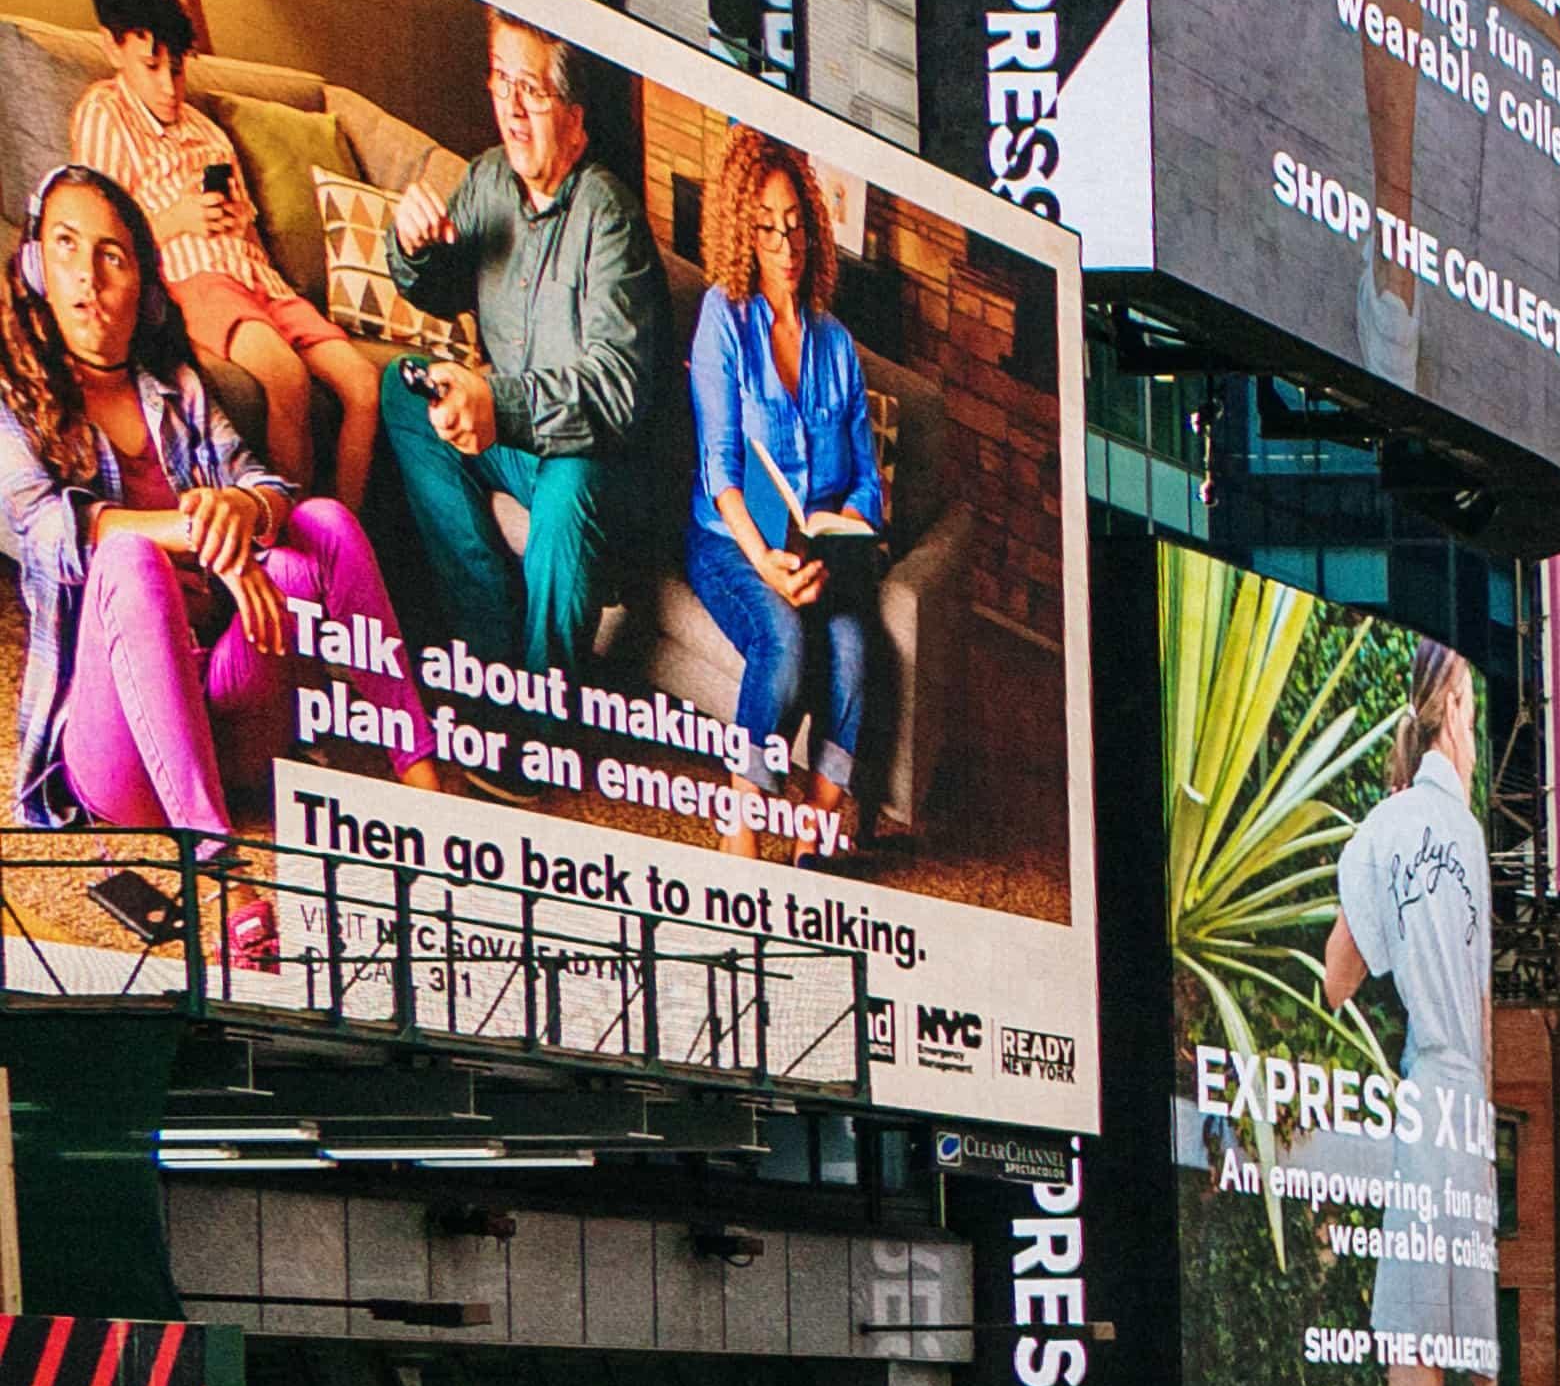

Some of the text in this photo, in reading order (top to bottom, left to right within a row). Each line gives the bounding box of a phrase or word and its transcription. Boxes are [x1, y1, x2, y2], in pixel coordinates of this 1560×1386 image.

[1489, 10, 1533, 88] fun
[1272, 152, 1439, 285] SHOP THE
[285, 597, 792, 773] Talk about making a
[296, 680, 852, 855] plan for an emergency.
[293, 789, 930, 971] Then go back to not talking.
[917, 1004, 983, 1049] NYC
[1001, 1029, 1075, 1064] READY
[1001, 1059, 1076, 1084] NEW YORK
[1195, 1044, 1461, 1153] EXPRESS X
[1220, 1147, 1473, 1225] An empowering, fun
[1328, 1223, 1448, 1265] wearable
[1304, 1327, 1417, 1366] SHOP THE
